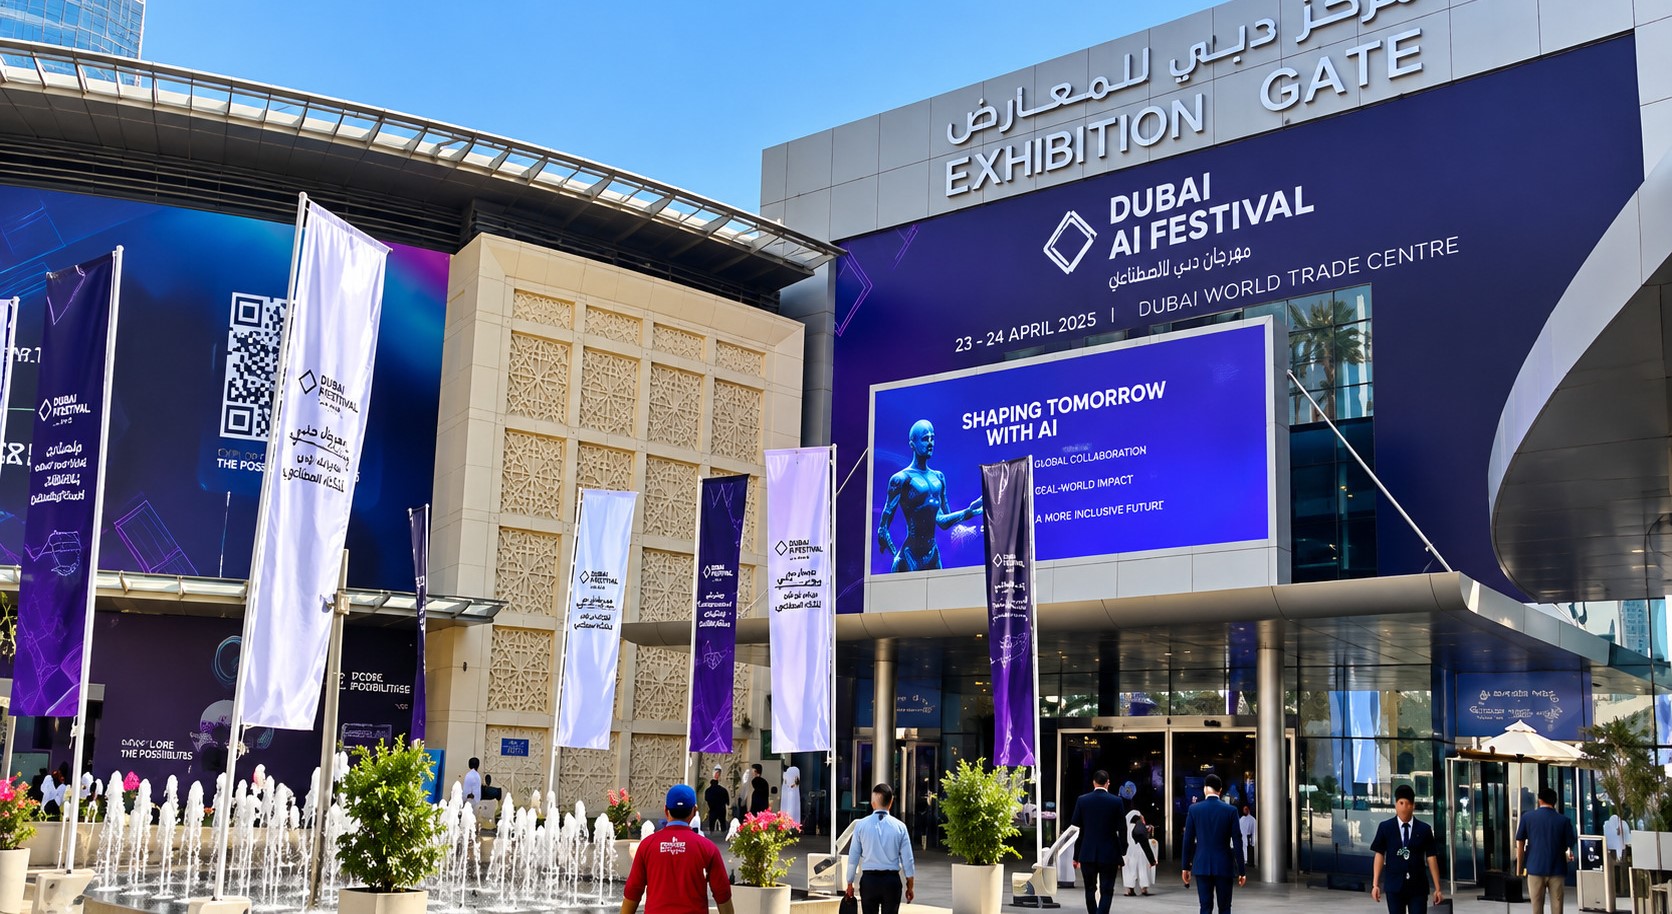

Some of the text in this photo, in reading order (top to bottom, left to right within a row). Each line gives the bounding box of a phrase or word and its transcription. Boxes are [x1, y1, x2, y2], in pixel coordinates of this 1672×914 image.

[1169, 18, 1277, 84] دبي
[945, 27, 1424, 198] EXHIBITION GATE
[947, 46, 1150, 146] للمعارض
[1109, 172, 1211, 225] DUBAI
[1108, 185, 1315, 260] AI FESTIVAL
[1203, 246, 1252, 271] مهرجان
[955, 337, 972, 352] 23
[986, 329, 1005, 347] 24
[1008, 320, 1055, 342] APRIL
[1058, 312, 1097, 333] 2025
[1139, 290, 1198, 317] DUBAI
[1203, 274, 1281, 304] WORLD
[1287, 256, 1360, 286] TRADE
[1367, 236, 1459, 270] CENTRE
[962, 380, 1167, 430] SHAPING TOMORROW
[986, 419, 1057, 446] WITH AI
[216, 458, 238, 470] THE
[1034, 456, 1069, 469] GLOBAL
[1070, 445, 1147, 464] COLLABORATION
[1097, 474, 1134, 488] IMPACT
[1035, 514, 1042, 523] A
[1044, 511, 1072, 523] MORE
[1074, 505, 1124, 519] INCLUSIVE
[121, 749, 138, 758] THE
